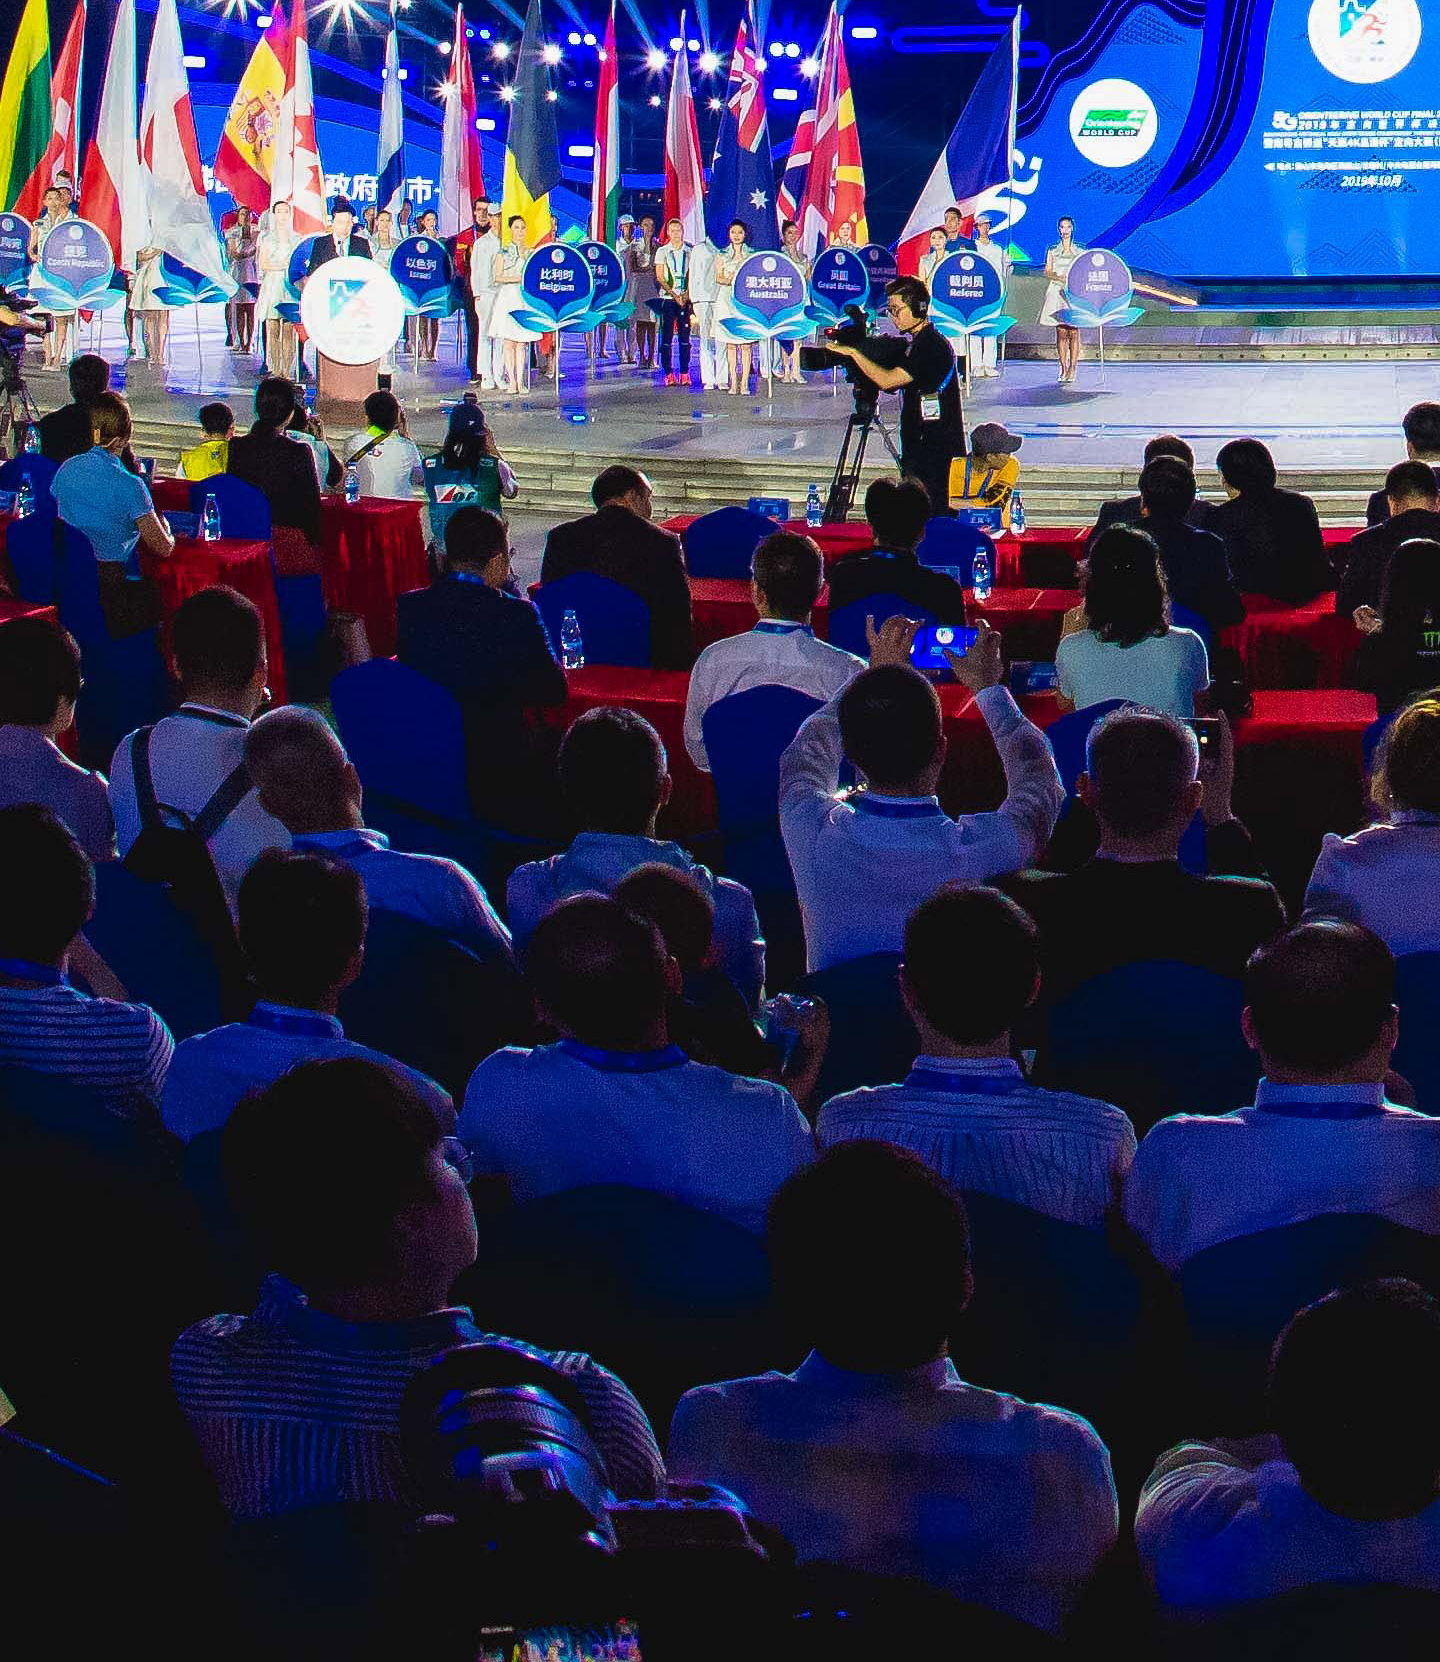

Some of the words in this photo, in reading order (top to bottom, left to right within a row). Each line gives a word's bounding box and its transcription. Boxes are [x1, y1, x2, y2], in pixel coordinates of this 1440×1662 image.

[1340, 174, 1403, 189] 2019年10月
[406, 259, 437, 272] 以色列
[540, 268, 574, 283] 比利时
[539, 281, 575, 294] Belgium
[749, 289, 789, 300] Australia
